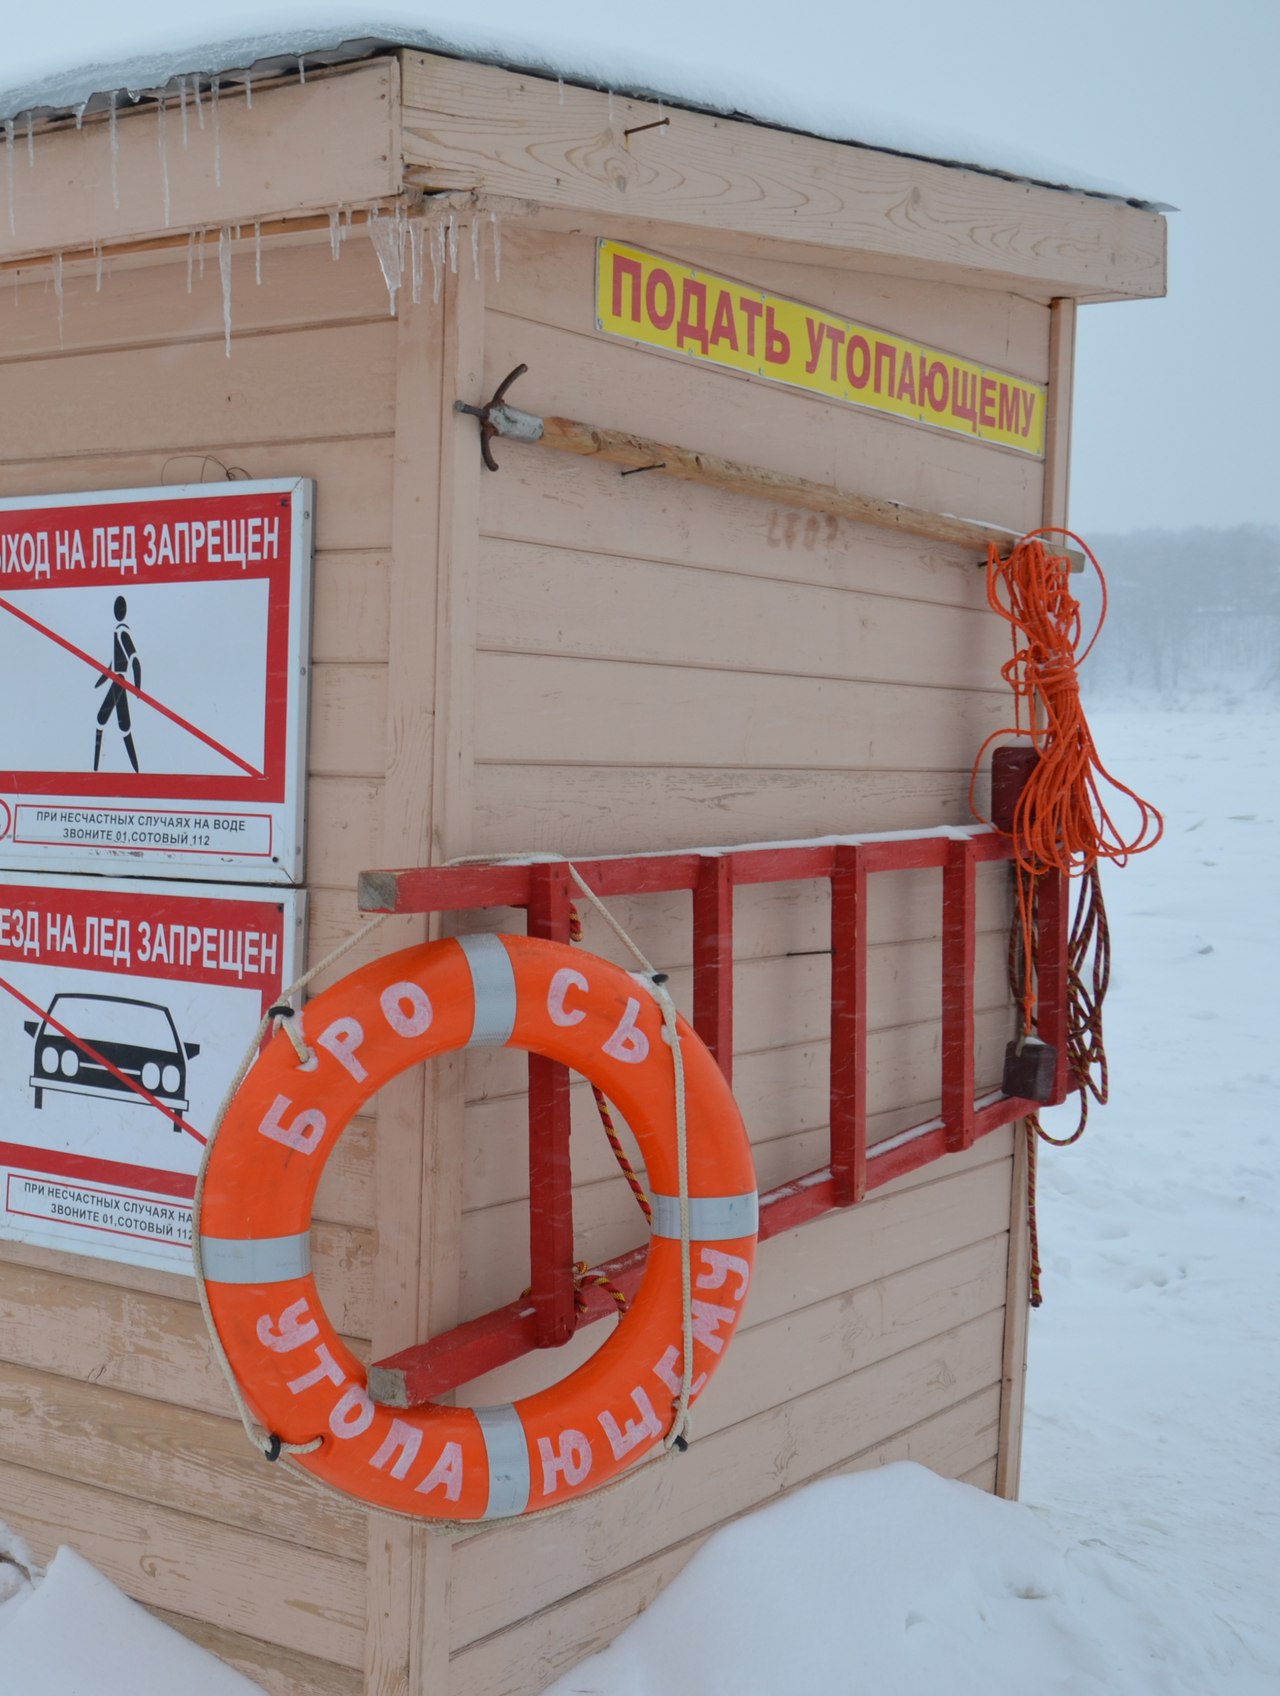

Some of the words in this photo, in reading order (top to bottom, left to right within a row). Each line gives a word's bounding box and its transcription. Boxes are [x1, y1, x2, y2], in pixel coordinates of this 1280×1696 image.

[612, 253, 791, 365] ПОДАТЬ
[805, 316, 1035, 439] УТОПАЮЩЕМУ
[56, 529, 85, 571] НА
[91, 526, 137, 575] ЛЕД
[143, 517, 279, 568] ЗАПРЕЩЕН
[37, 812, 57, 822] ПРИ
[60, 813, 134, 826] НЕСЧАСТНЫХ
[138, 816, 191, 829] СЛУЧАЯХ
[194, 819, 210, 829] НА
[214, 820, 245, 831] ВОДЕ
[63, 829, 112, 840] ЗВОНИТЕ
[193, 835, 210, 846] 112
[47, 914, 77, 953] НА
[83, 916, 131, 967] ЛЕД
[138, 921, 277, 979] ЗАПРЕЩЕН
[258, 967, 650, 1155] БРОСЬ
[25, 1182, 44, 1195] ПРИ
[48, 1187, 120, 1210] НЕСЧАСТНЫХ
[124, 1202, 174, 1221] СЛУЧАЯХ
[178, 1212, 192, 1223] НА
[51, 1204, 99, 1222] ЗВОНИТЕ
